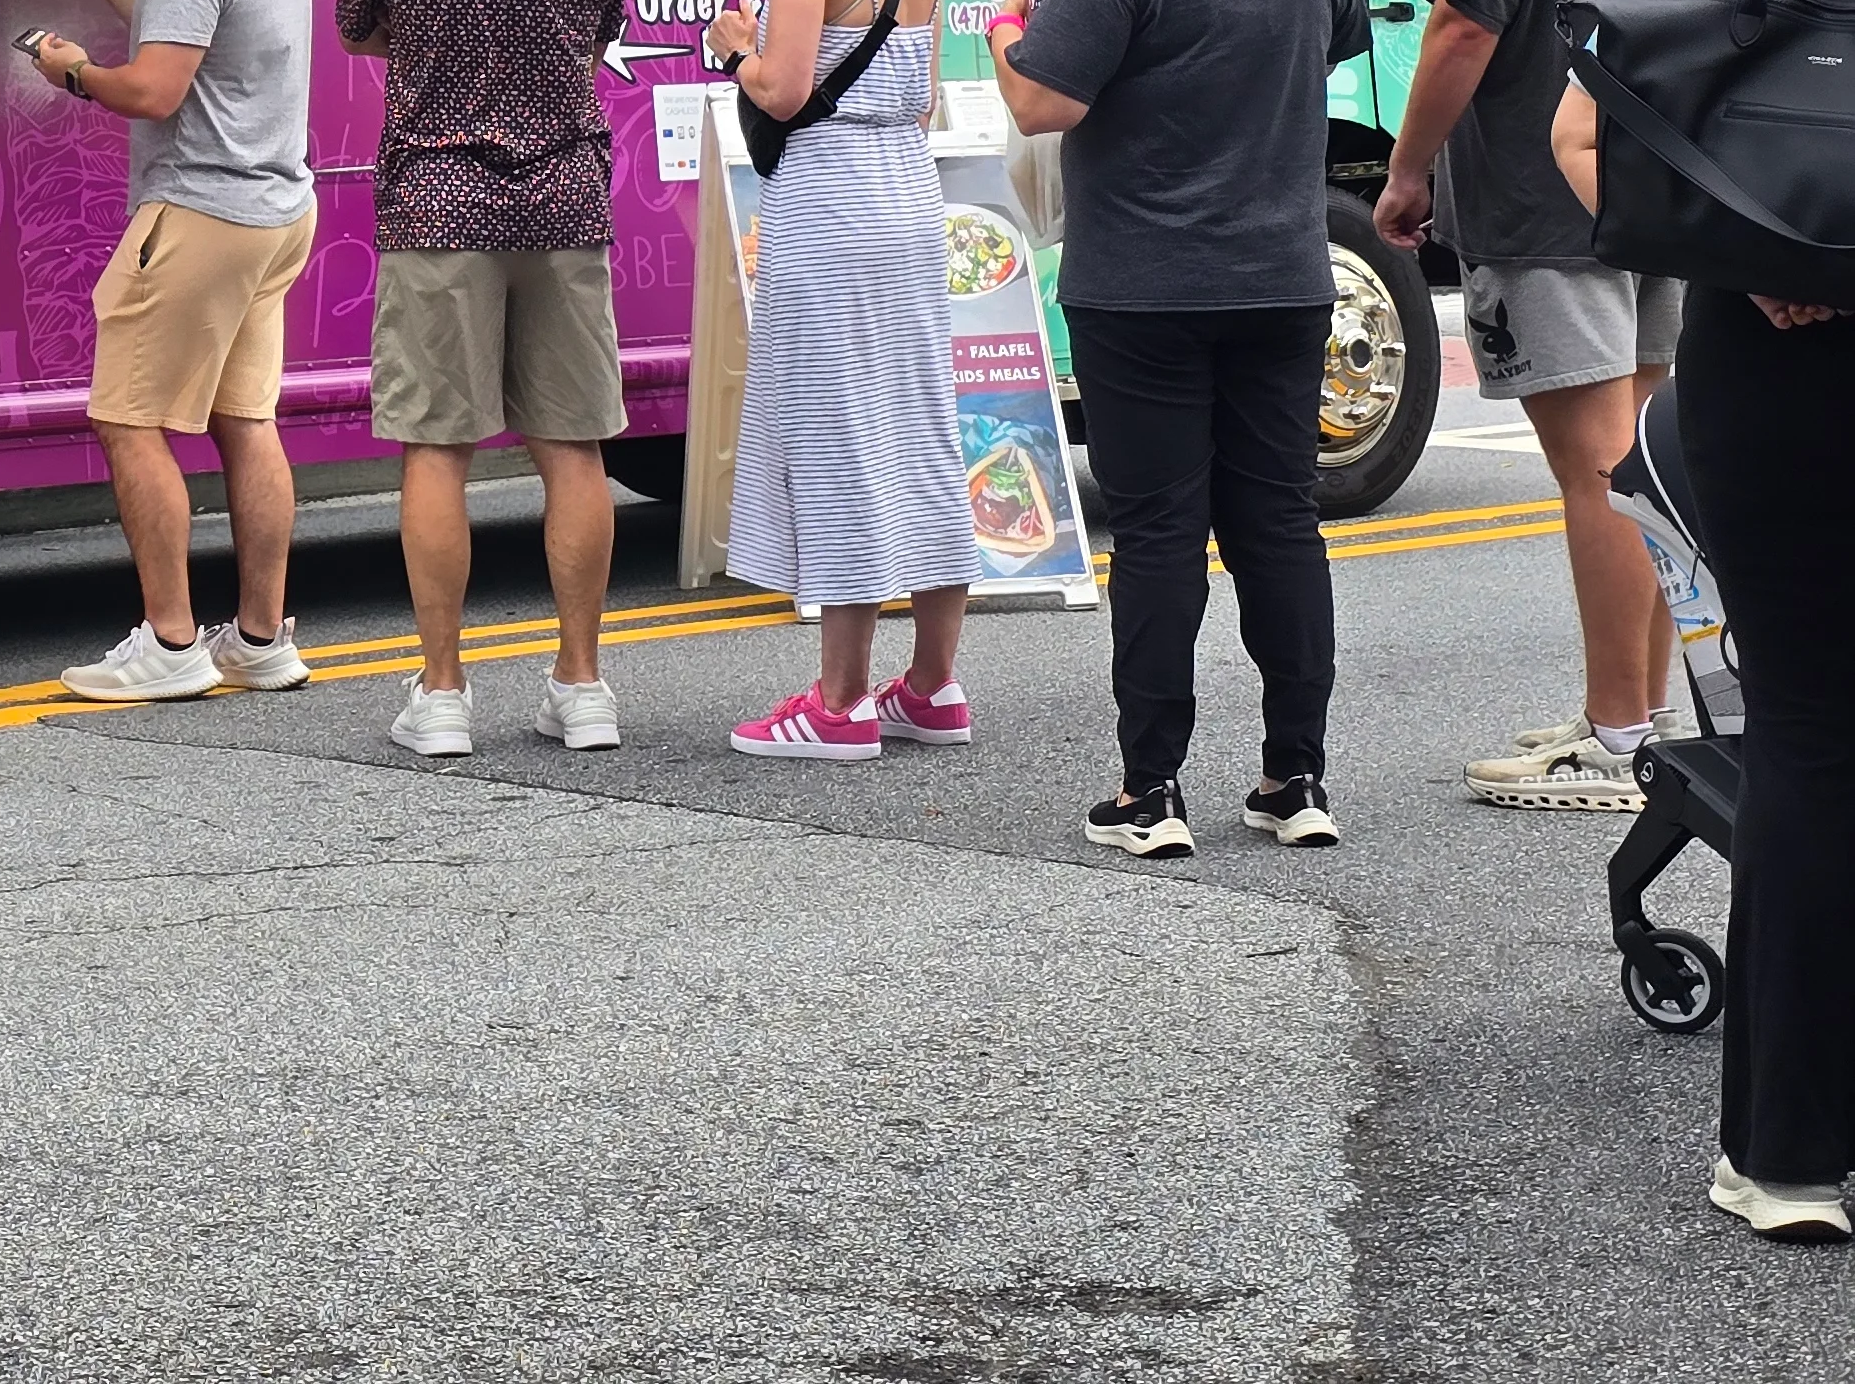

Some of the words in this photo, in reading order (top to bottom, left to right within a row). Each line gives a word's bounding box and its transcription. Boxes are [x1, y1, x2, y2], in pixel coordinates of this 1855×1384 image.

[969, 342, 1035, 359] FALAFEL
[952, 369, 986, 384] KIDS
[989, 367, 1041, 382] MEALS
[1481, 359, 1532, 381] PLAYBOY
